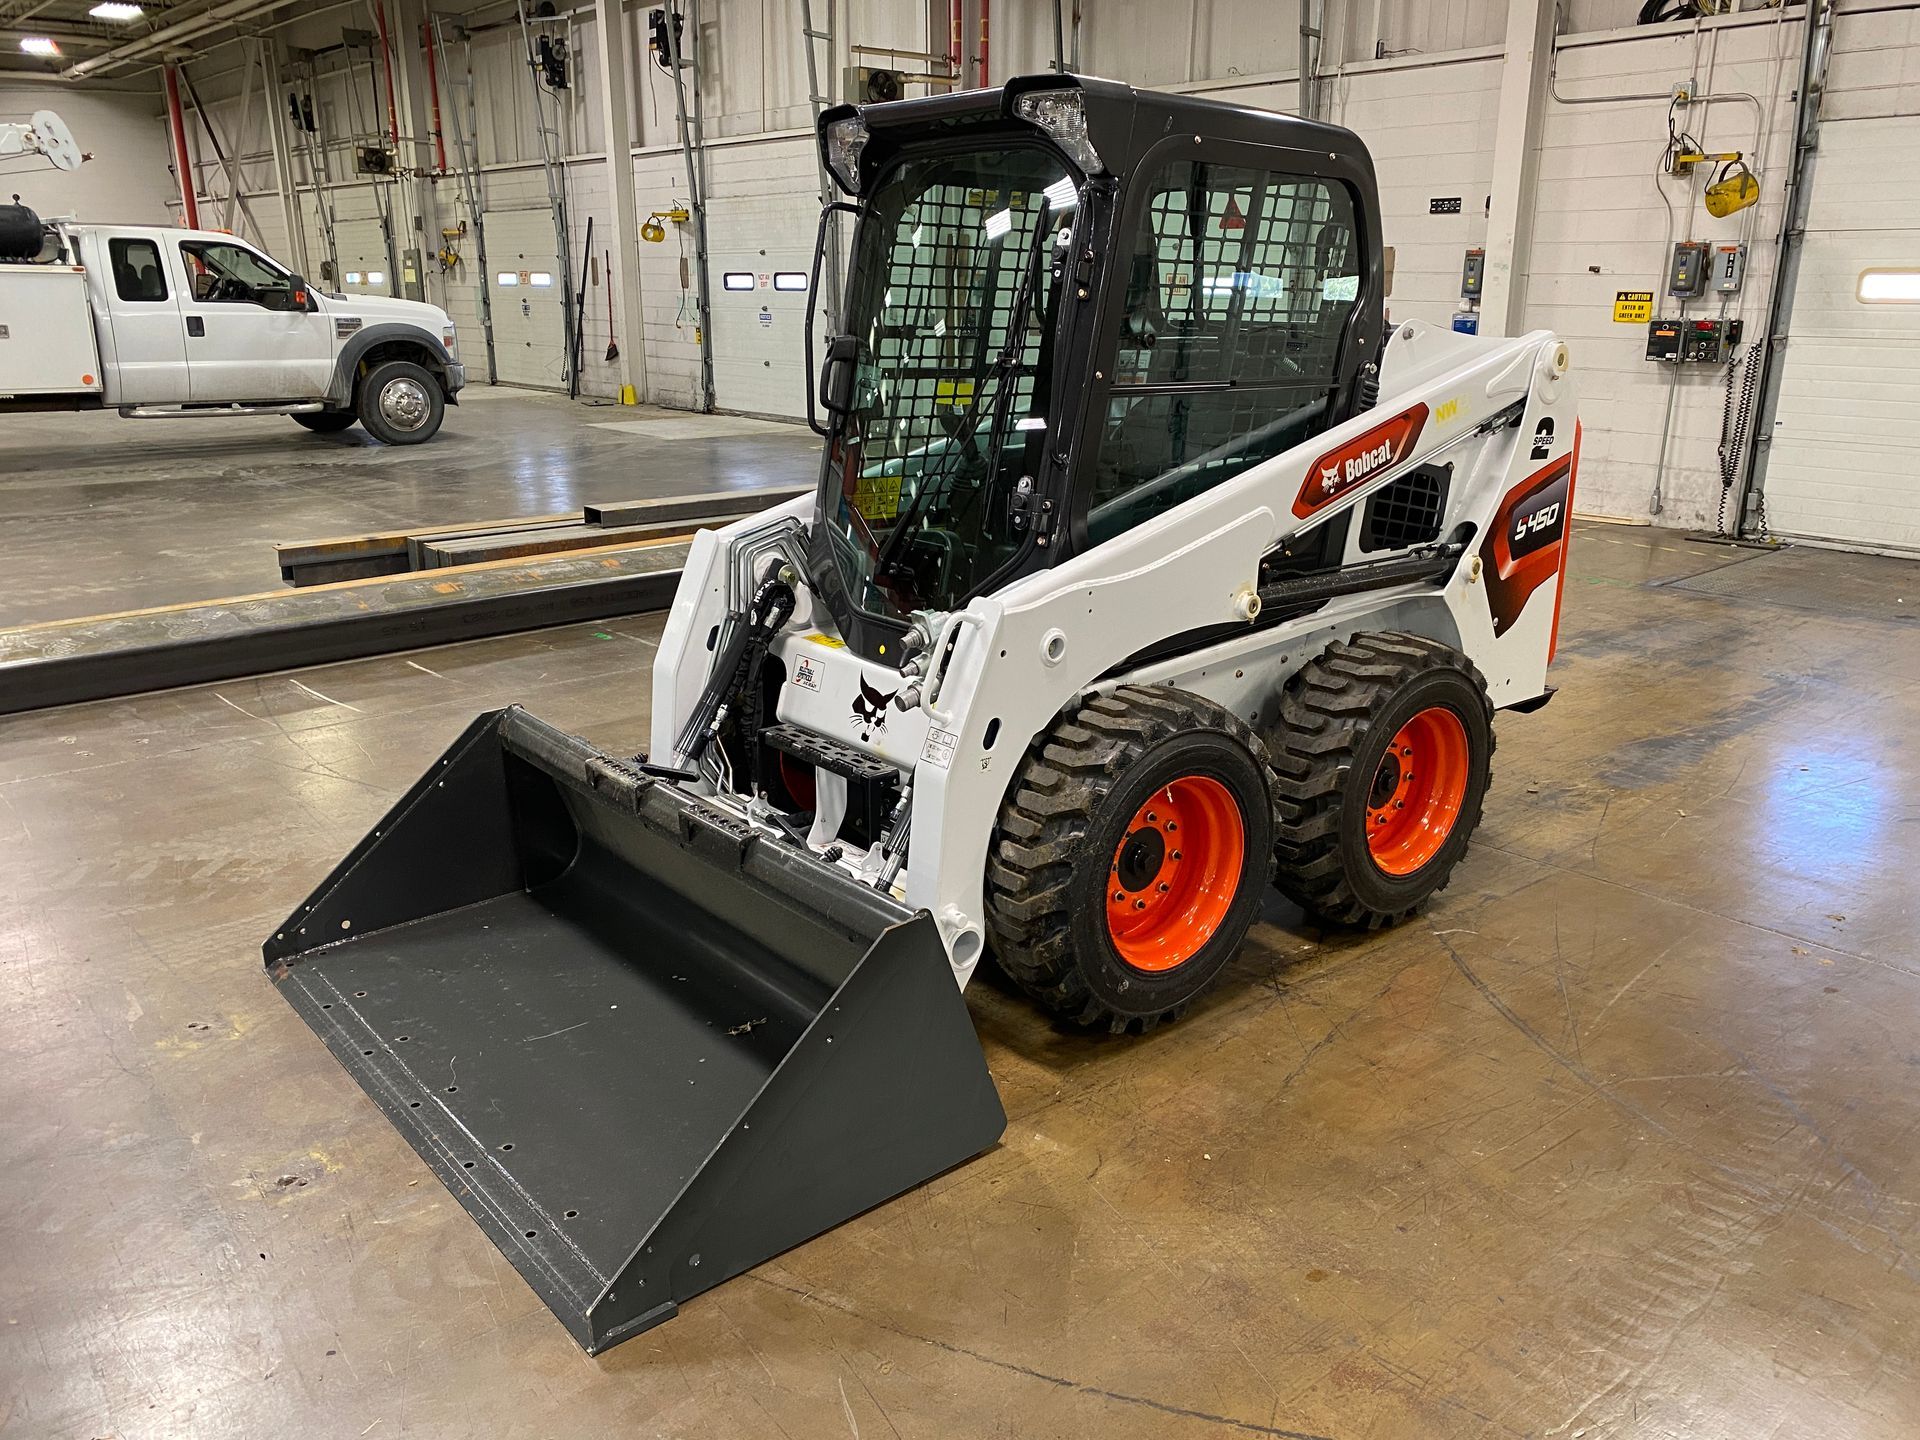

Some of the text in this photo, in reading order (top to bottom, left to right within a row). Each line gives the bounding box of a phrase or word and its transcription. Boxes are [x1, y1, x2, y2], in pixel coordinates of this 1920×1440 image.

[1627, 293, 1650, 301] CAUTION
[1530, 417, 1554, 460] 2
[1533, 436, 1555, 446] SPEED
[1345, 438, 1391, 482] Bobcat
[1514, 502, 1560, 541] S450
